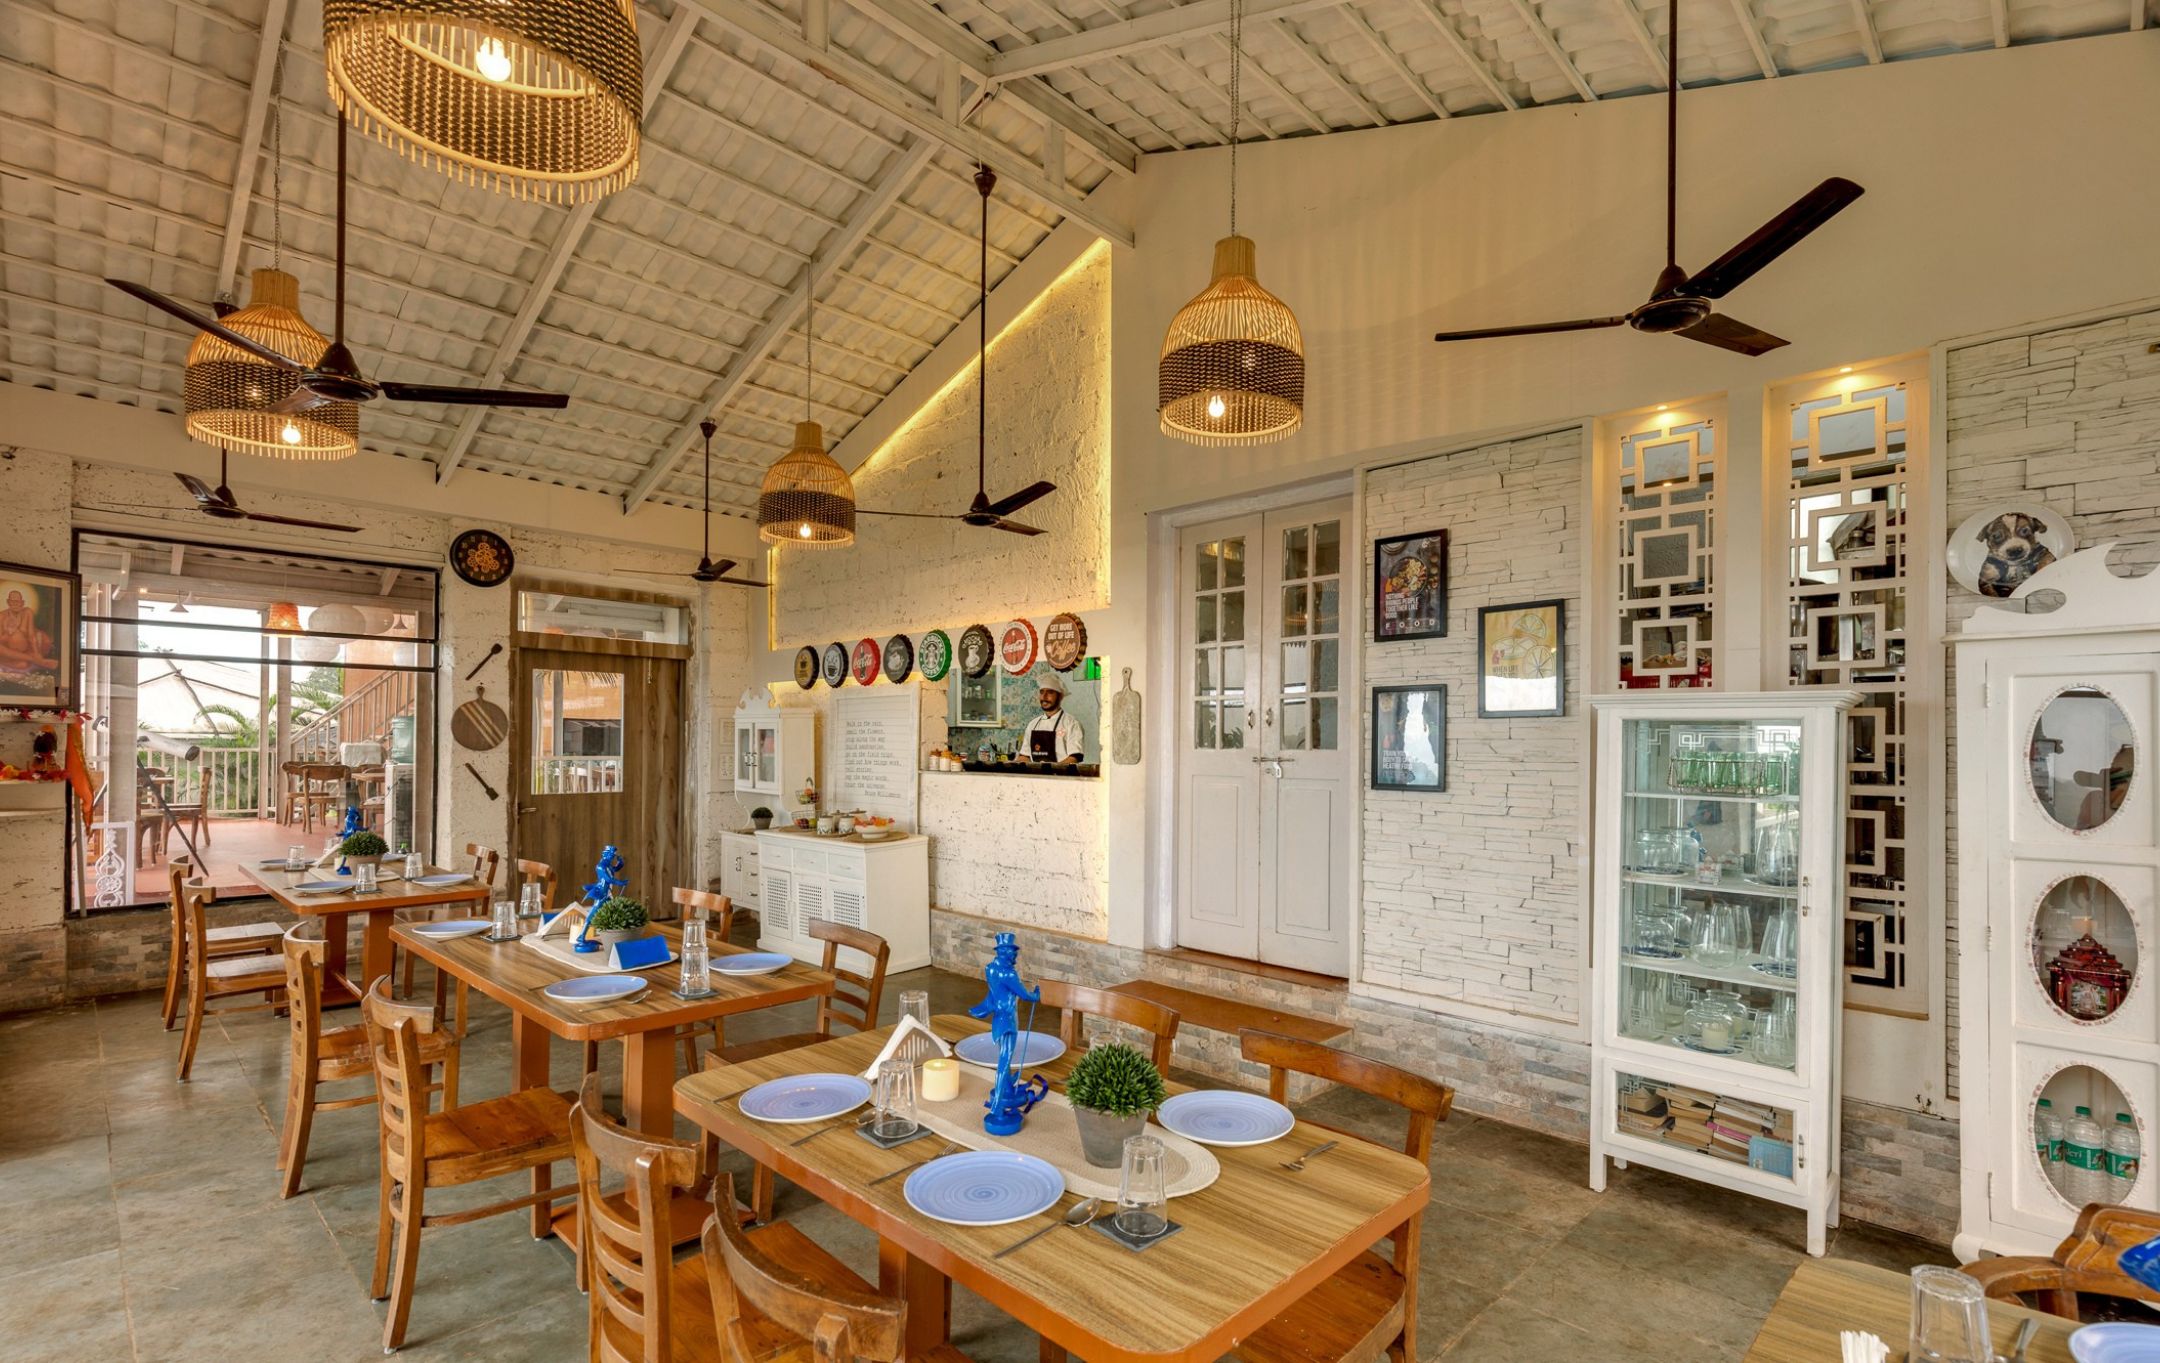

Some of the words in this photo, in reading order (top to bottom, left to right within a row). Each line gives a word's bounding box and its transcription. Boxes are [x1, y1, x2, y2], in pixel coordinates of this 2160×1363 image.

[1050, 624, 1058, 632] GET
[1065, 631, 1074, 639] LIFE
[1051, 640, 1077, 660] Coffee
